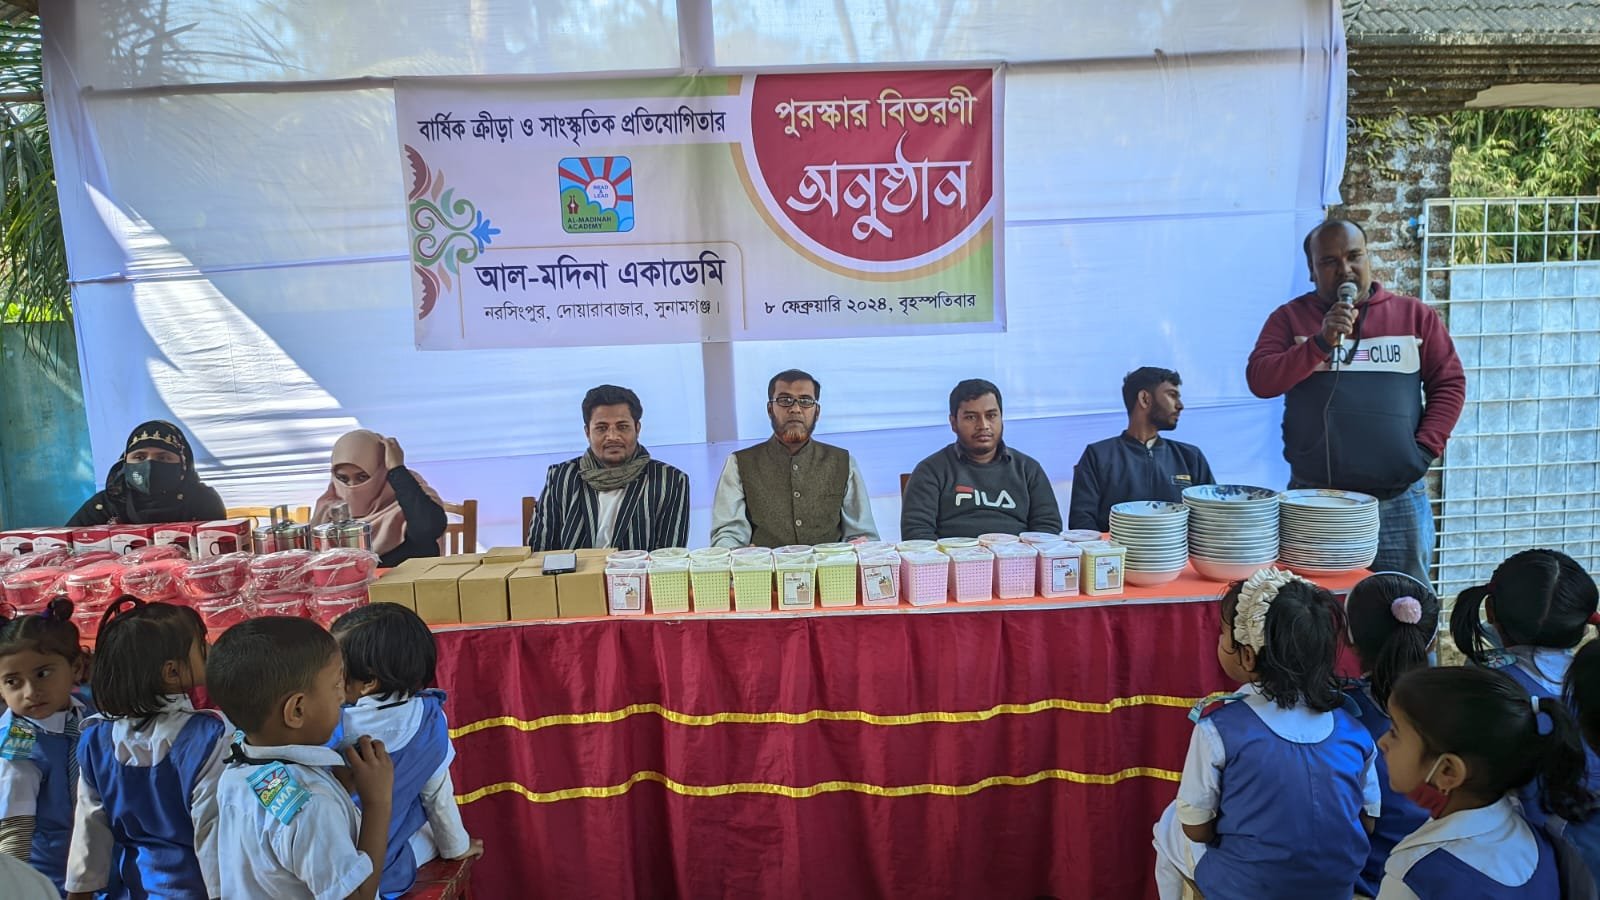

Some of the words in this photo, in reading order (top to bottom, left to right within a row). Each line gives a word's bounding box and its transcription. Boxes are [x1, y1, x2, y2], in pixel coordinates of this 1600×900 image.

[417, 112, 466, 143] বার্ষিক
[471, 110, 514, 143] ক্রীড়া
[520, 119, 533, 138] ও
[538, 108, 616, 147] সাংস্কৃতিক
[621, 105, 727, 136] প্রতিযোগিতার
[775, 97, 871, 137] পুরস্কার
[876, 86, 978, 128] বিতরণী
[786, 130, 972, 241] অনুষ্ঠান
[474, 254, 610, 292] আল-মদিনা
[618, 250, 727, 288] একাডেমি
[484, 300, 551, 324] নরসিংপুর,
[556, 301, 649, 320] দোয়ারাবাজার,
[765, 300, 776, 315] ৮
[782, 294, 842, 316] ফেব্রুয়ারি
[847, 297, 893, 314] ২০২৪,
[898, 291, 977, 316] বৃহস্পতিবার
[1370, 344, 1401, 364] CLUB
[955, 485, 1017, 509] FILA
[271, 786, 296, 815] AMA
